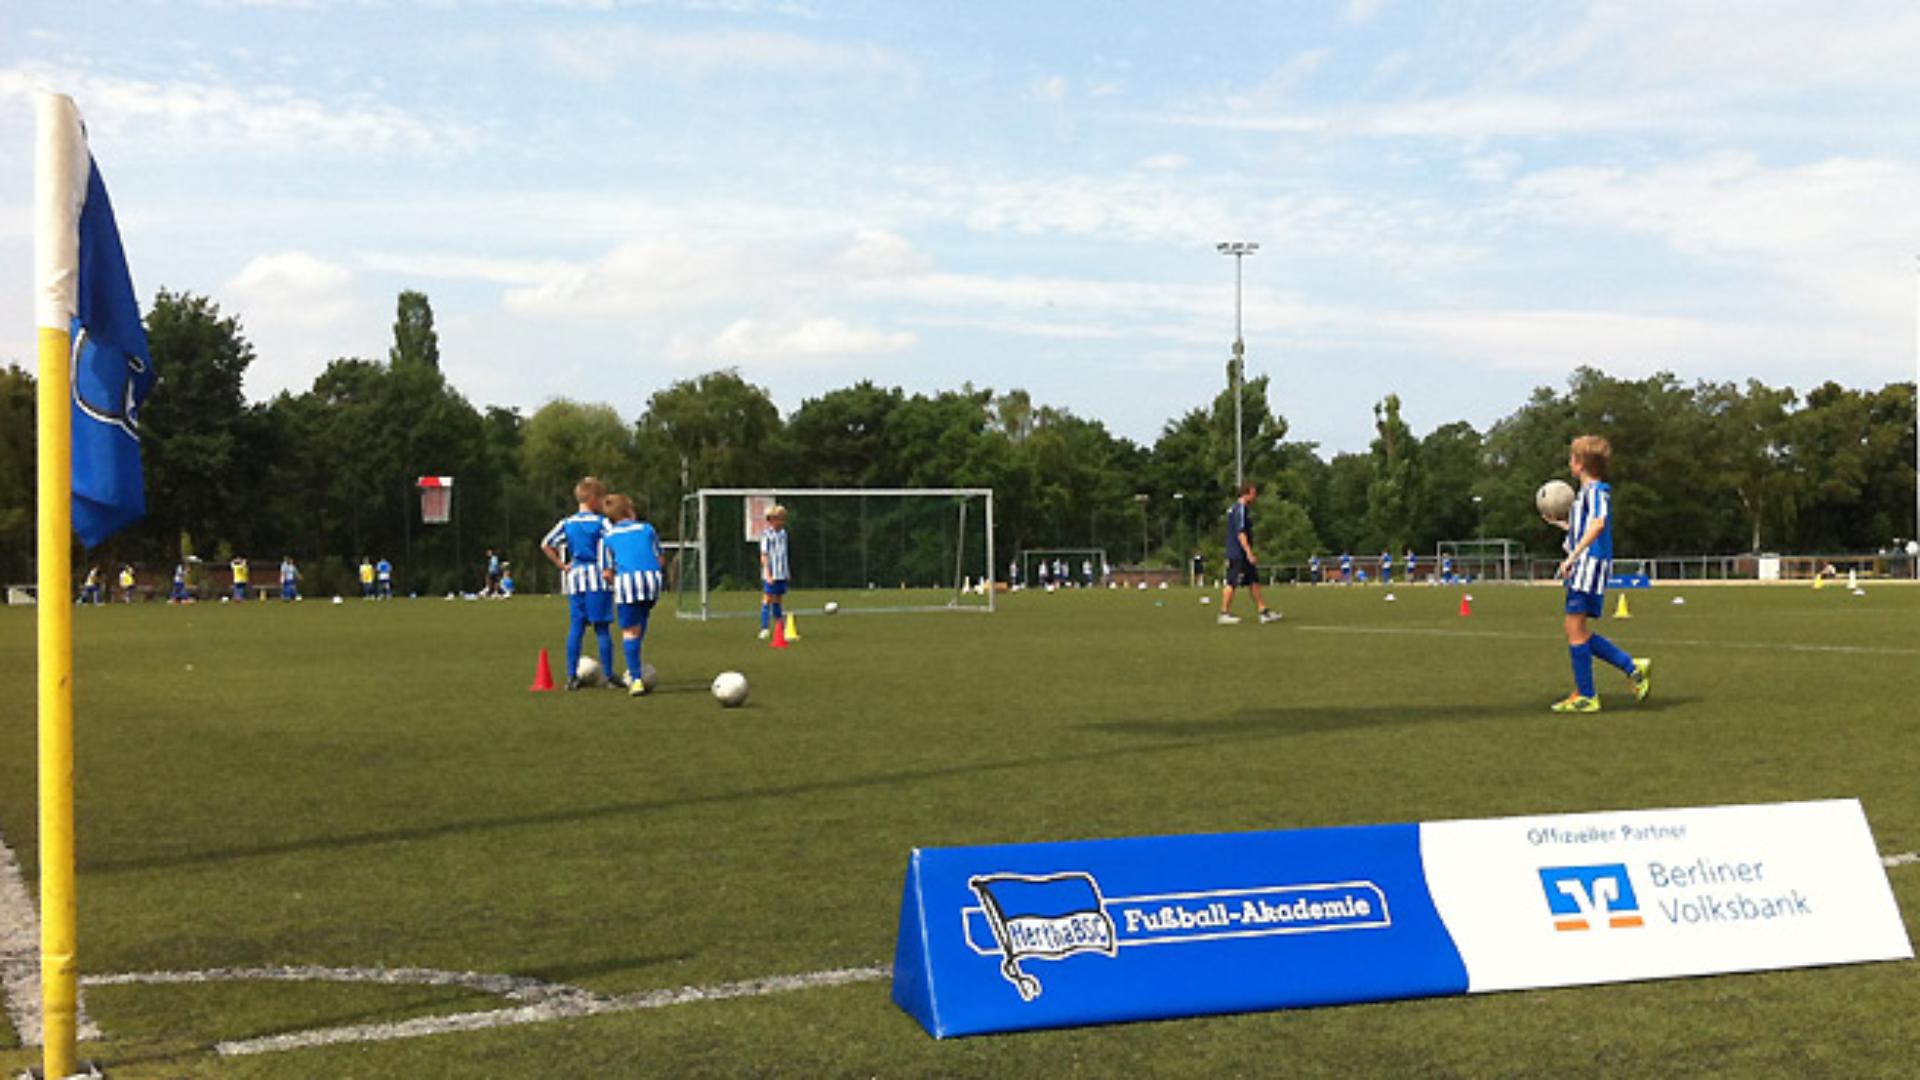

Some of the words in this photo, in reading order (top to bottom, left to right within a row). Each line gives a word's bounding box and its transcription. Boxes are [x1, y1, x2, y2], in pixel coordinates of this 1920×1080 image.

[1621, 824, 1687, 841] Partner
[1648, 857, 1763, 888] Berliner
[1123, 895, 1370, 932] Fußball-Akademie
[1658, 889, 1812, 923] Volksbank
